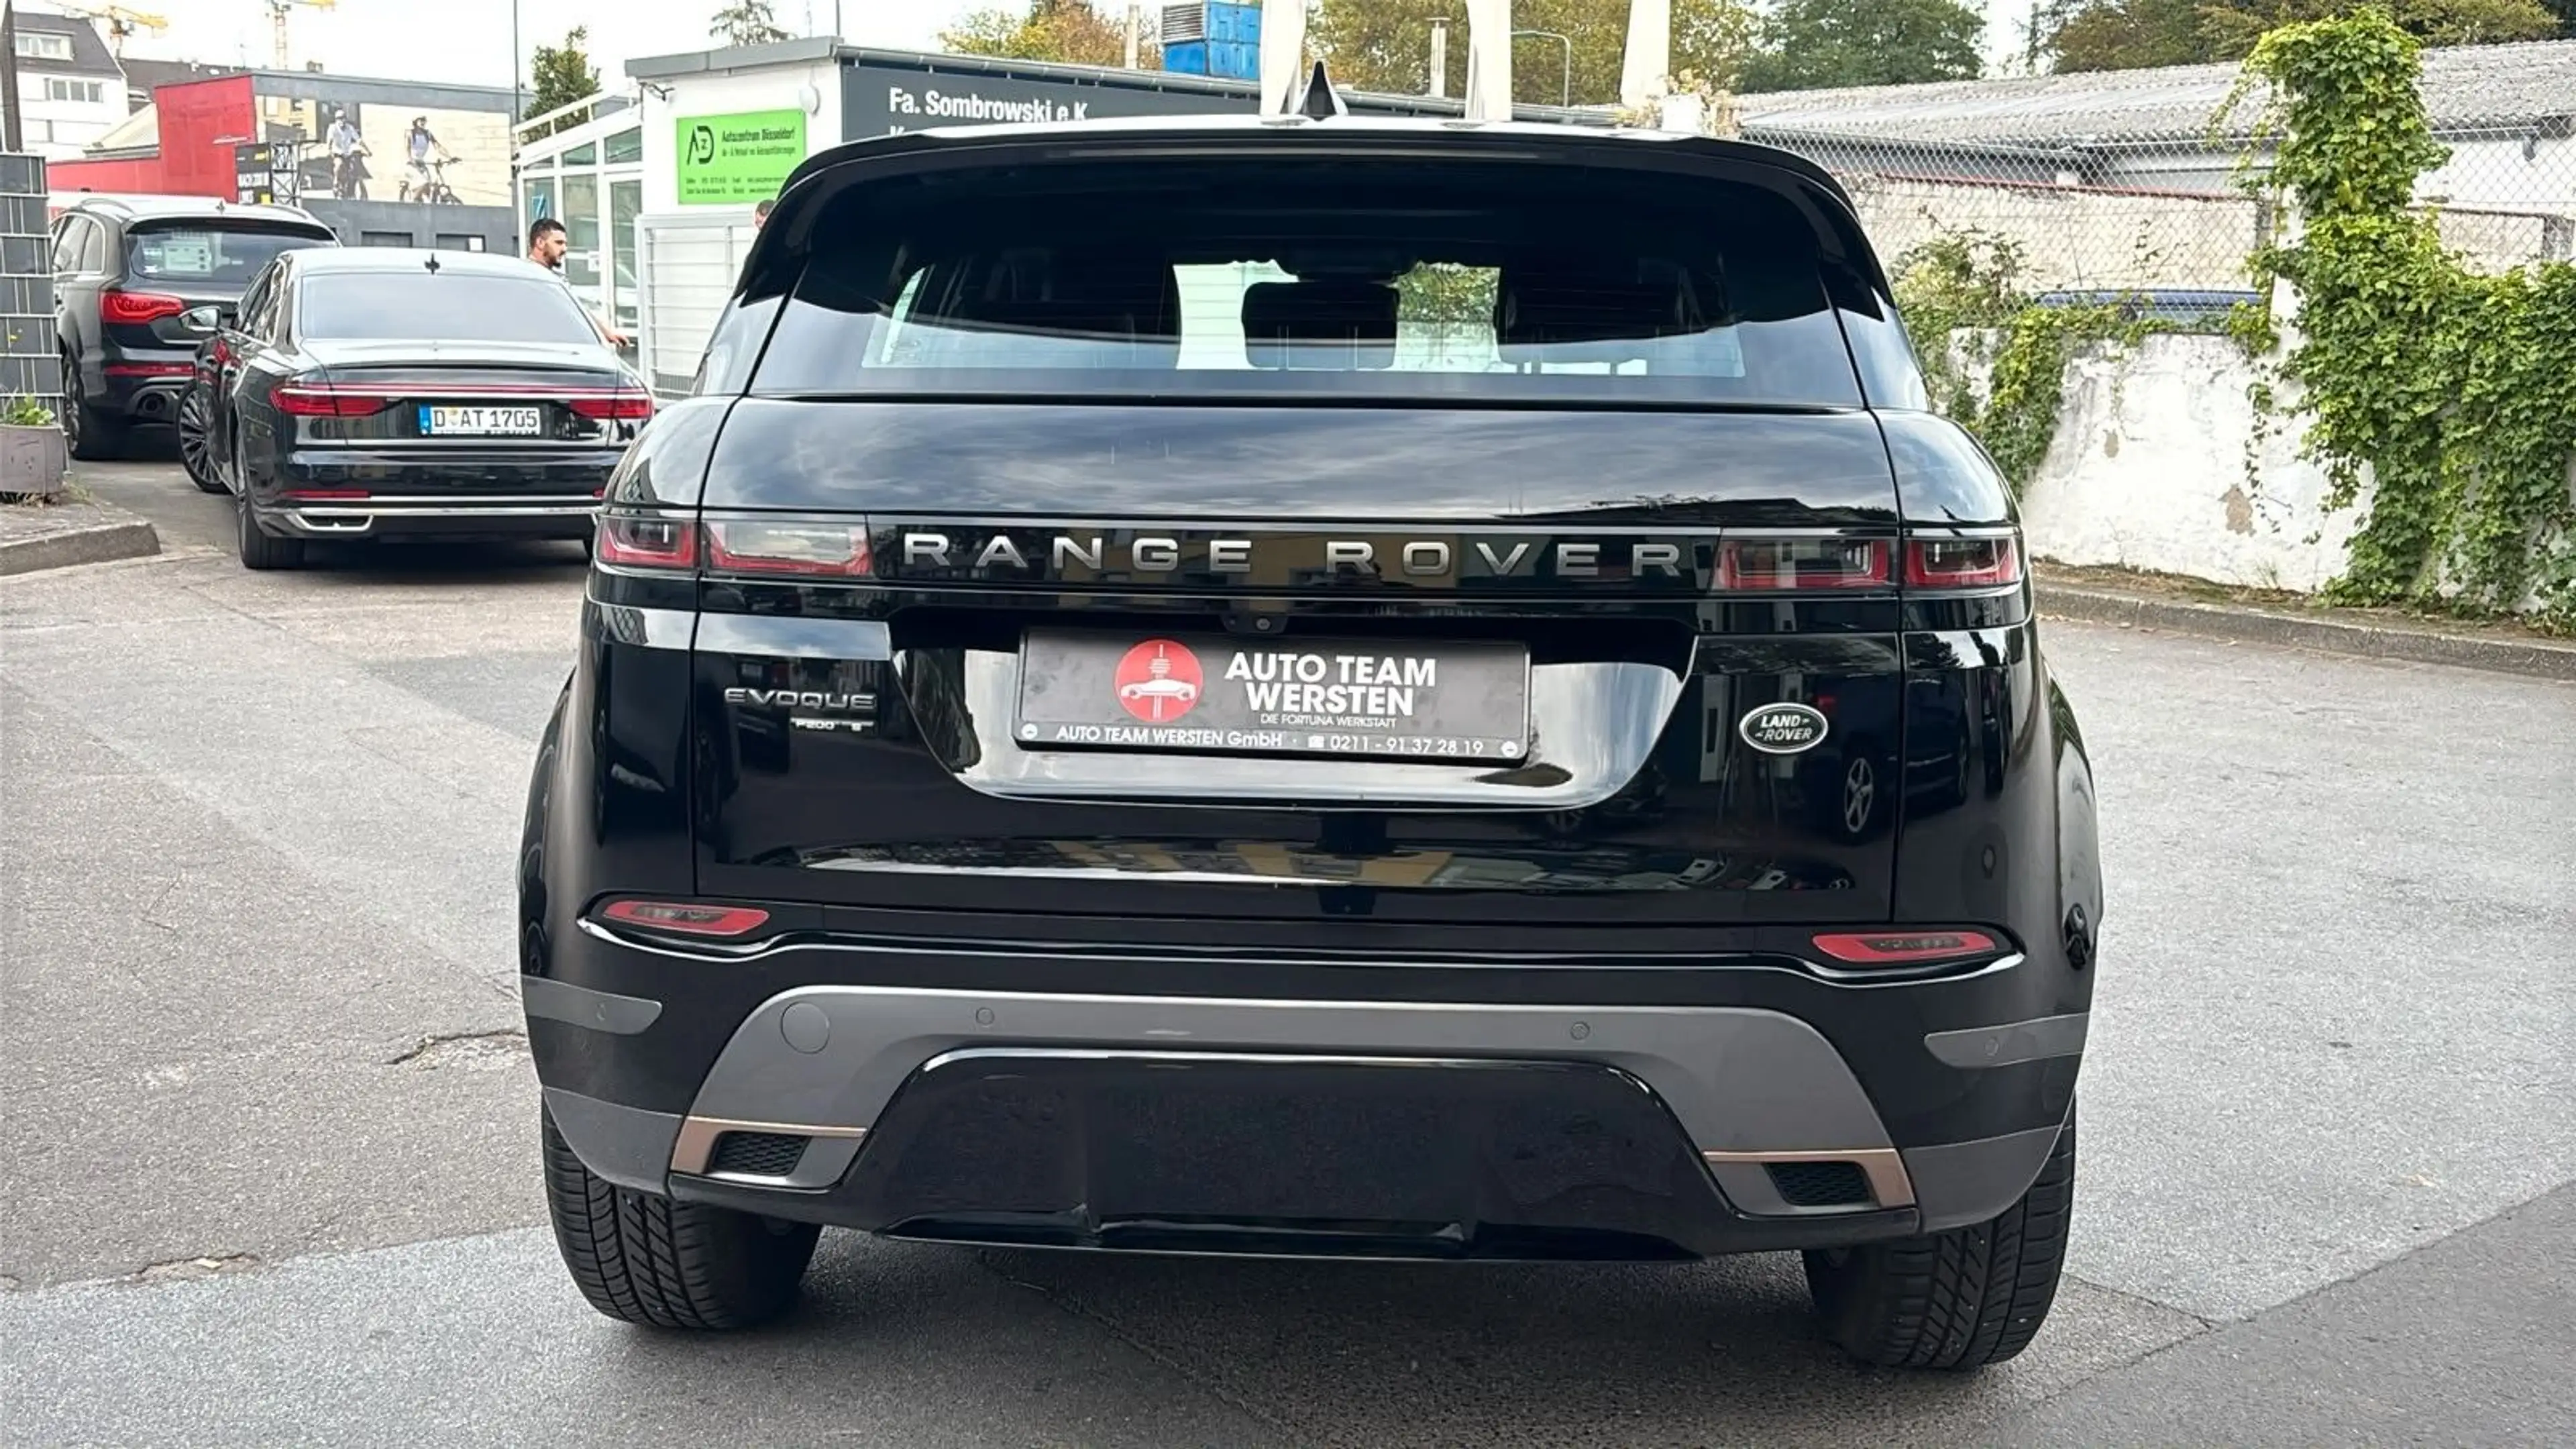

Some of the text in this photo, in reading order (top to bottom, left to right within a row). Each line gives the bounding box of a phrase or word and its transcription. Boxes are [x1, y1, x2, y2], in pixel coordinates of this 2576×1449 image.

[889, 87, 1089, 123] Fa. Sombrowski eK
[434, 411, 537, 427] D AT 1705
[904, 533, 1681, 576] RANGE ROVER
[1224, 652, 1436, 686] AUTO TEAM
[724, 688, 876, 708] EVOQUE
[1246, 682, 1413, 716] WERSTEN
[1260, 714, 1397, 728] DIE FORTUNA WERKSTATT
[1760, 714, 1801, 728] LAND
[1055, 726, 1283, 747] AUTO TEAM WERSTEN GmbH
[1330, 735, 1369, 751] 0211
[1387, 738, 1405, 753] 91
[1412, 739, 1432, 753] 37
[1438, 740, 1457, 754] 28
[1464, 741, 1484, 755] 19
[1764, 729, 1813, 741] ROVER
